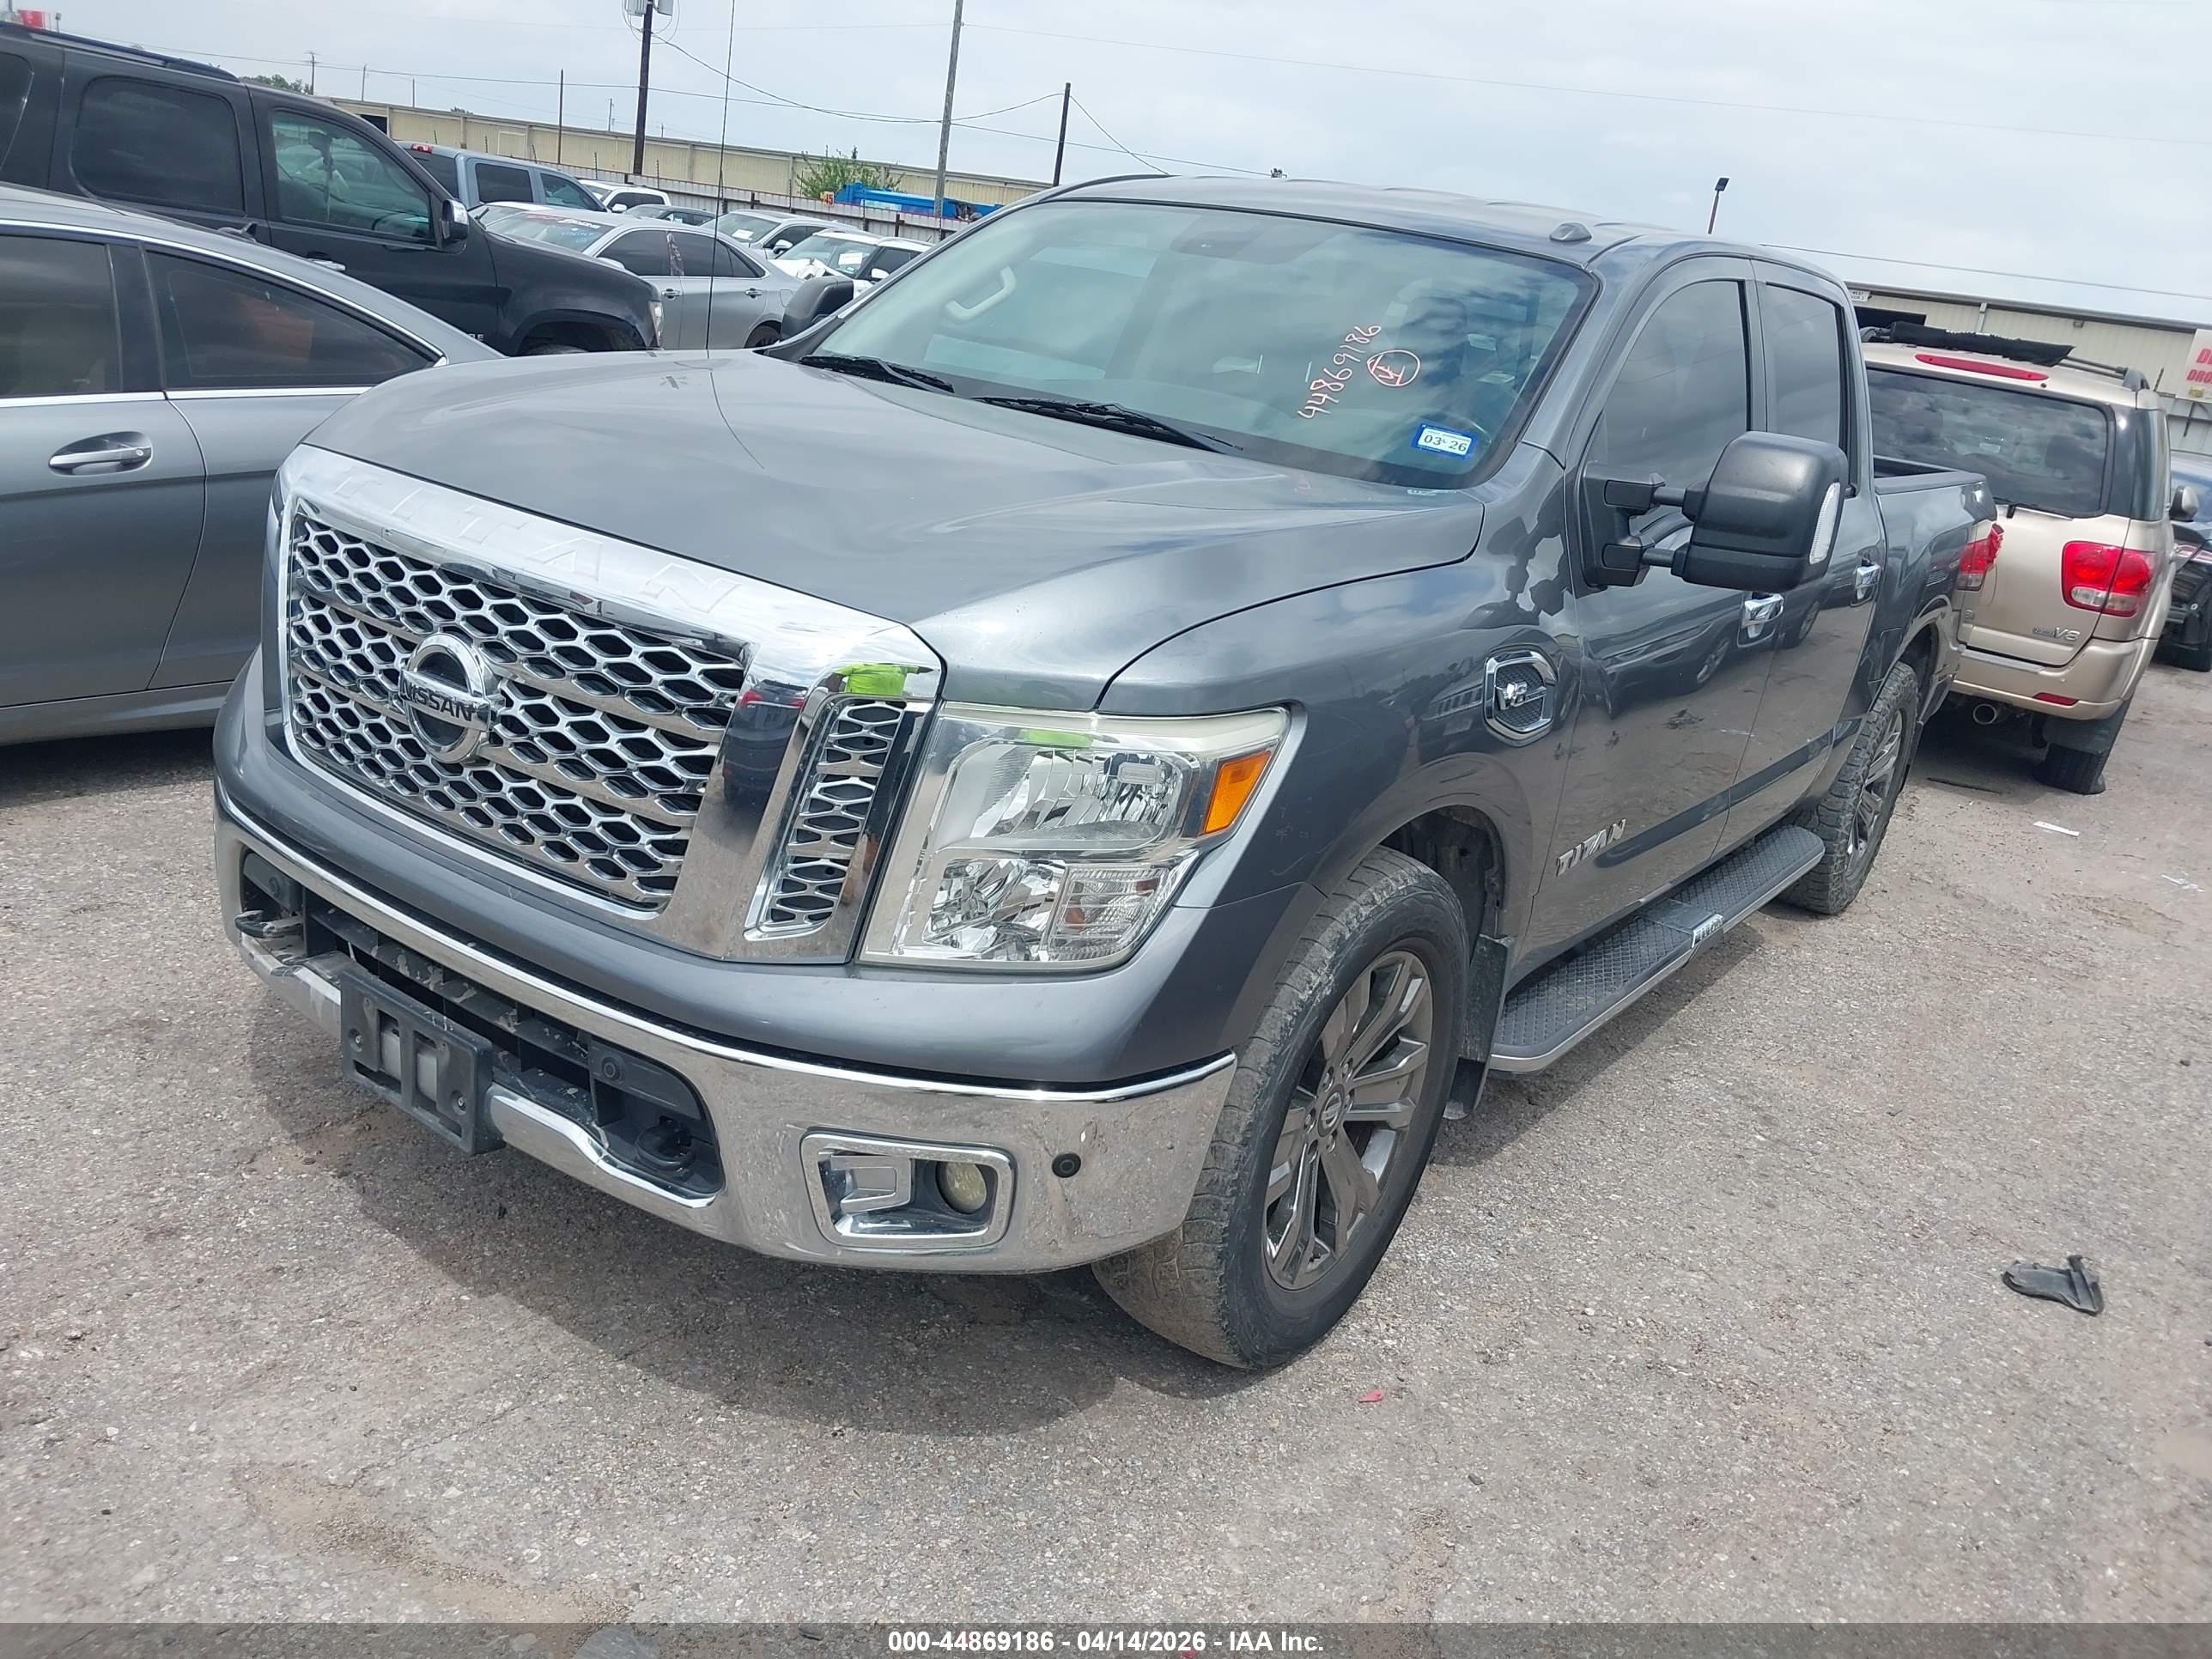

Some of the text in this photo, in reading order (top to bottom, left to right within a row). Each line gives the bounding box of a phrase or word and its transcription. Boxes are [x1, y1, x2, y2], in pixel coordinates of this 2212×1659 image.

[1297, 325, 1382, 419] 44869186
[1424, 434, 1442, 446] 03
[1448, 440, 1468, 452] 26
[400, 677, 472, 721] NISSAN
[1556, 818, 1626, 877] TITAN
